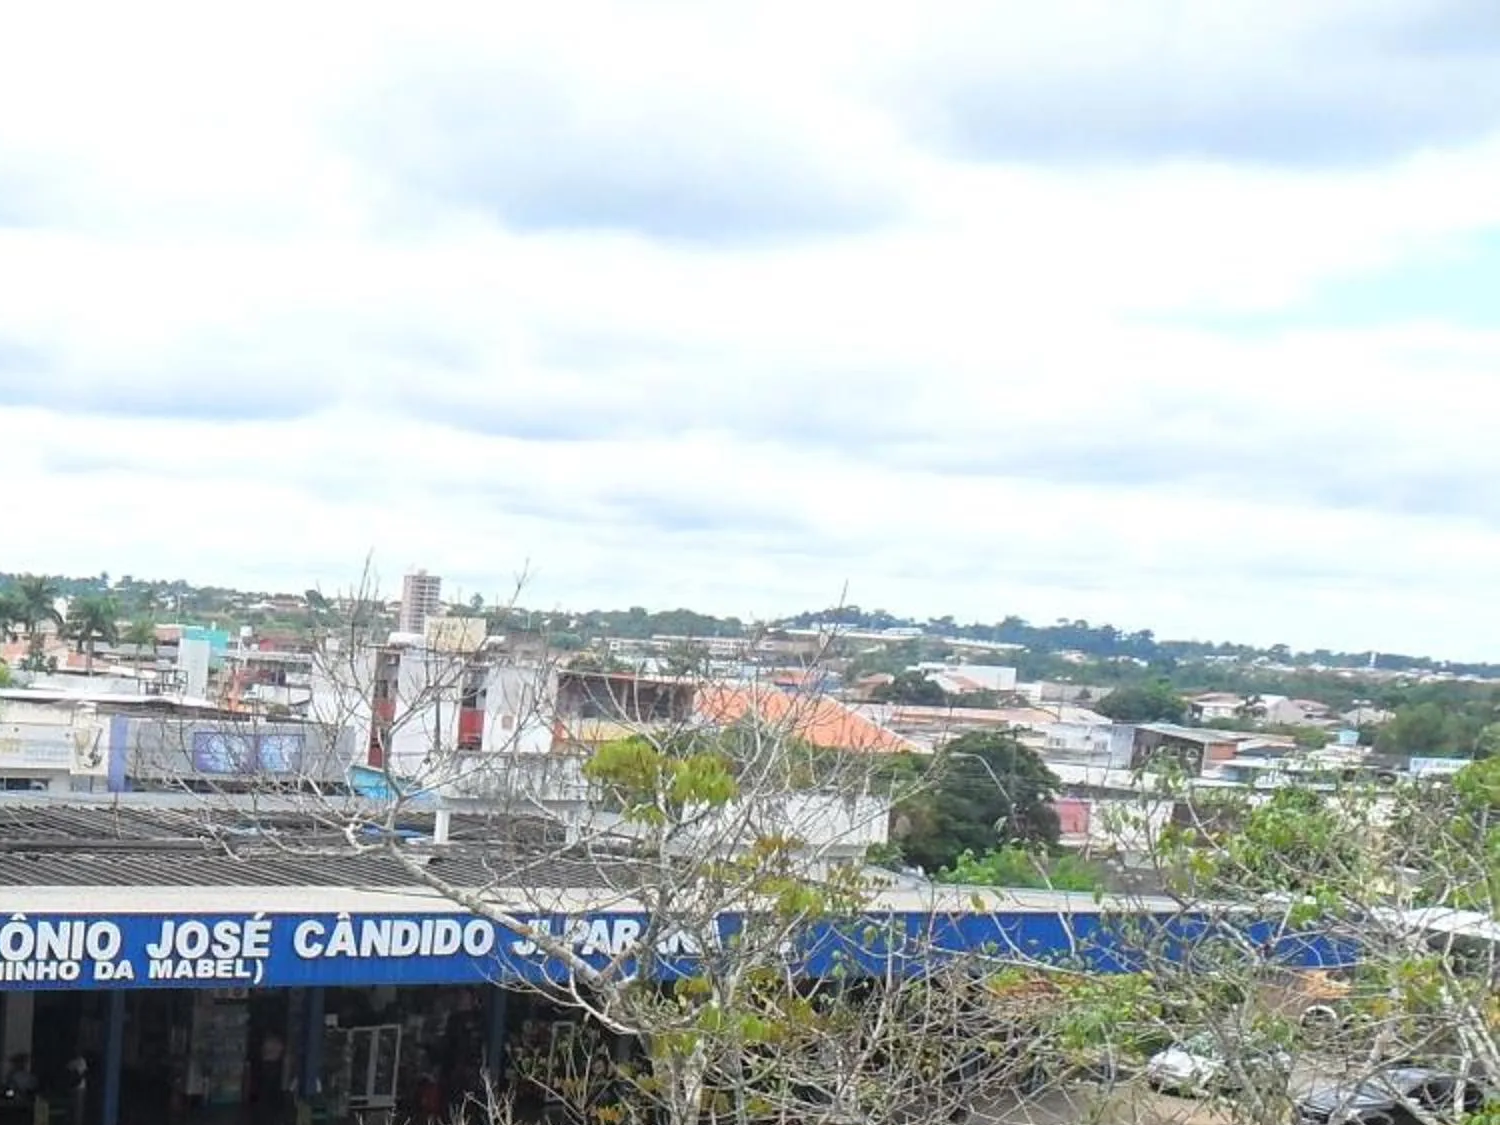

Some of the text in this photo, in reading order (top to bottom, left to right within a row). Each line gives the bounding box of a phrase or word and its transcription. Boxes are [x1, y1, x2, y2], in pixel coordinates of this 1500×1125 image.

[146, 912, 273, 960] JOSÉ
[293, 912, 496, 959] CÂNDIDO
[93, 960, 135, 981] DA
[148, 959, 264, 984] MABEL)
